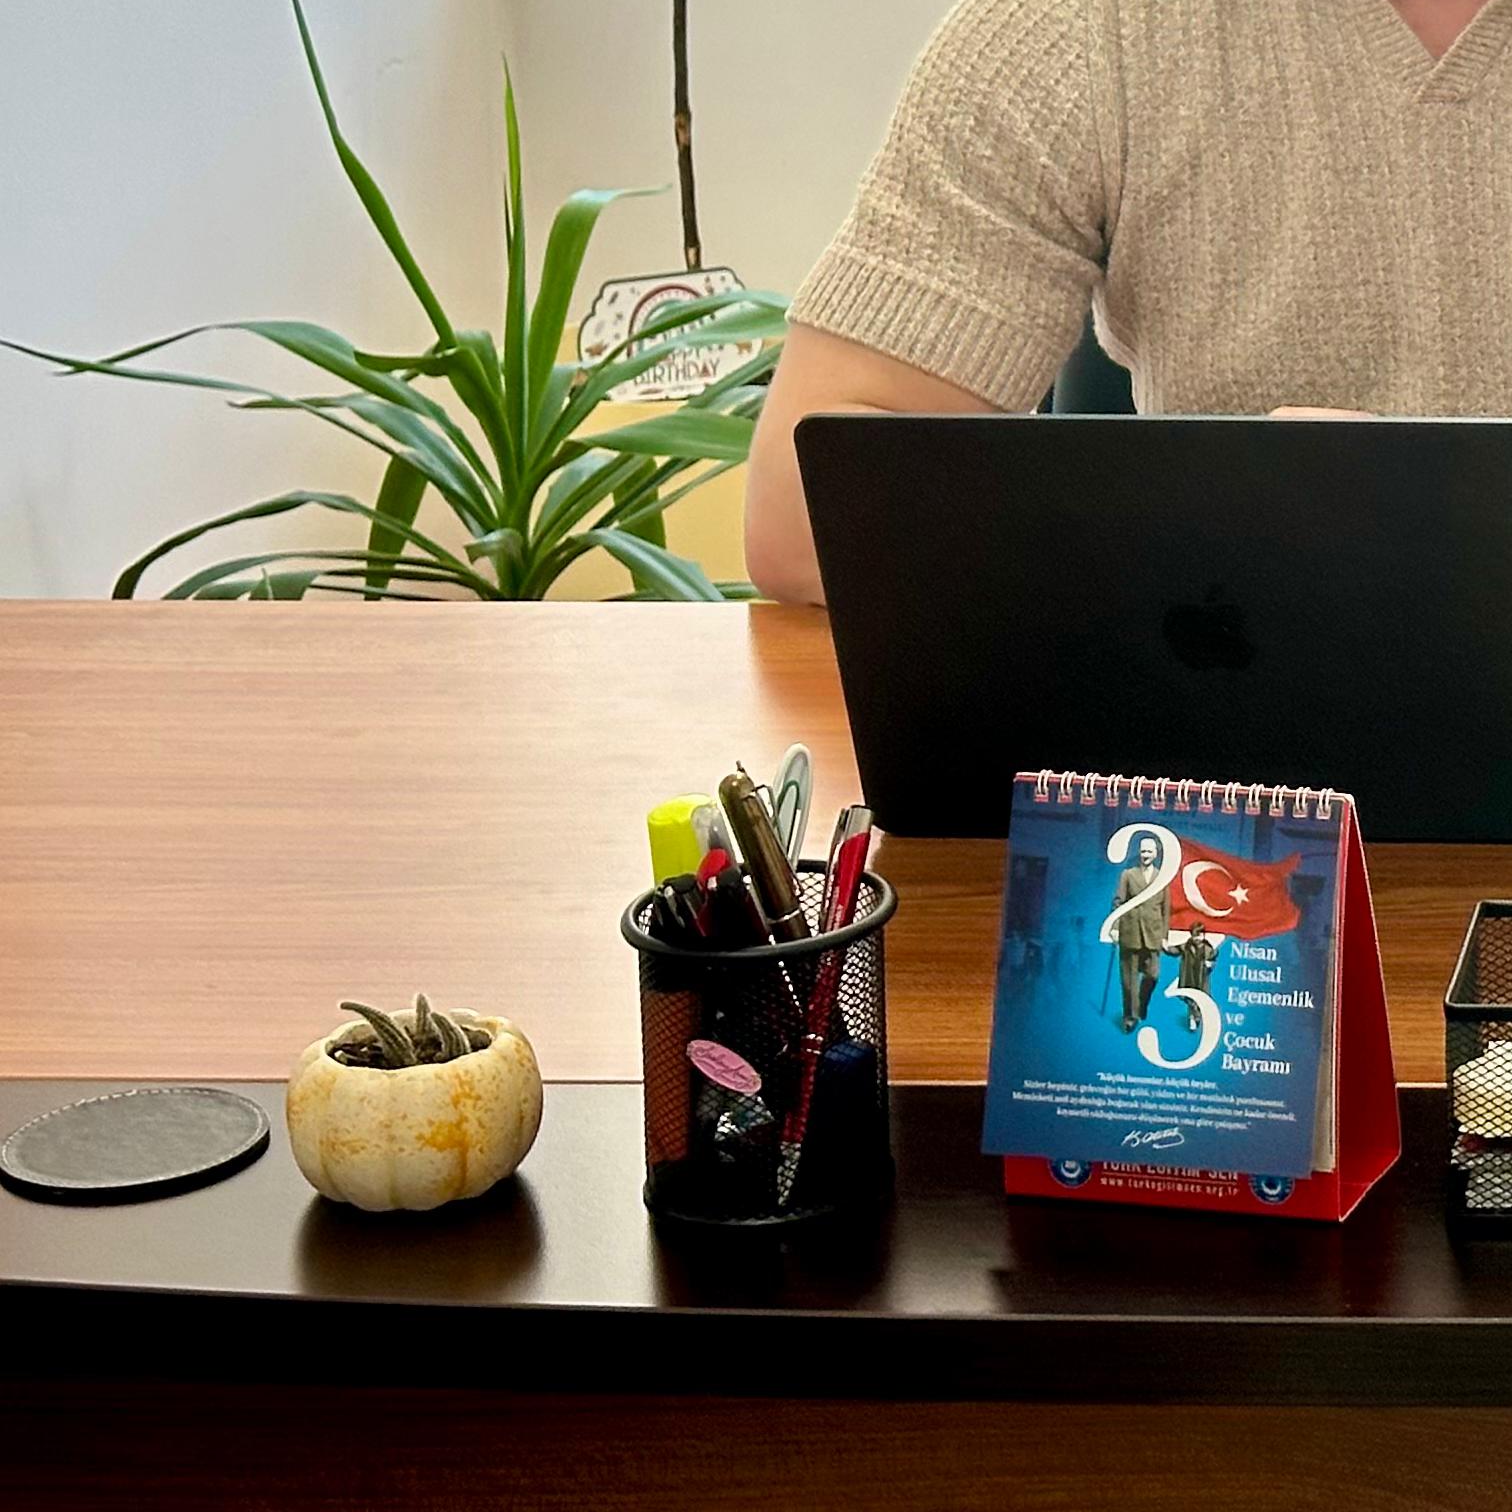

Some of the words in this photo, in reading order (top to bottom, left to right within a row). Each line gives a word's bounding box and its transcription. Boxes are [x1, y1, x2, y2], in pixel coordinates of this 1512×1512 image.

[1230, 942, 1277, 961] Nisan
[1229, 964, 1282, 984] Ulusal
[1227, 987, 1315, 1008] Egemenlik
[1225, 1012, 1245, 1026] ve
[1223, 1031, 1275, 1052] Çocuk
[1221, 1053, 1291, 1075] Bayramı
